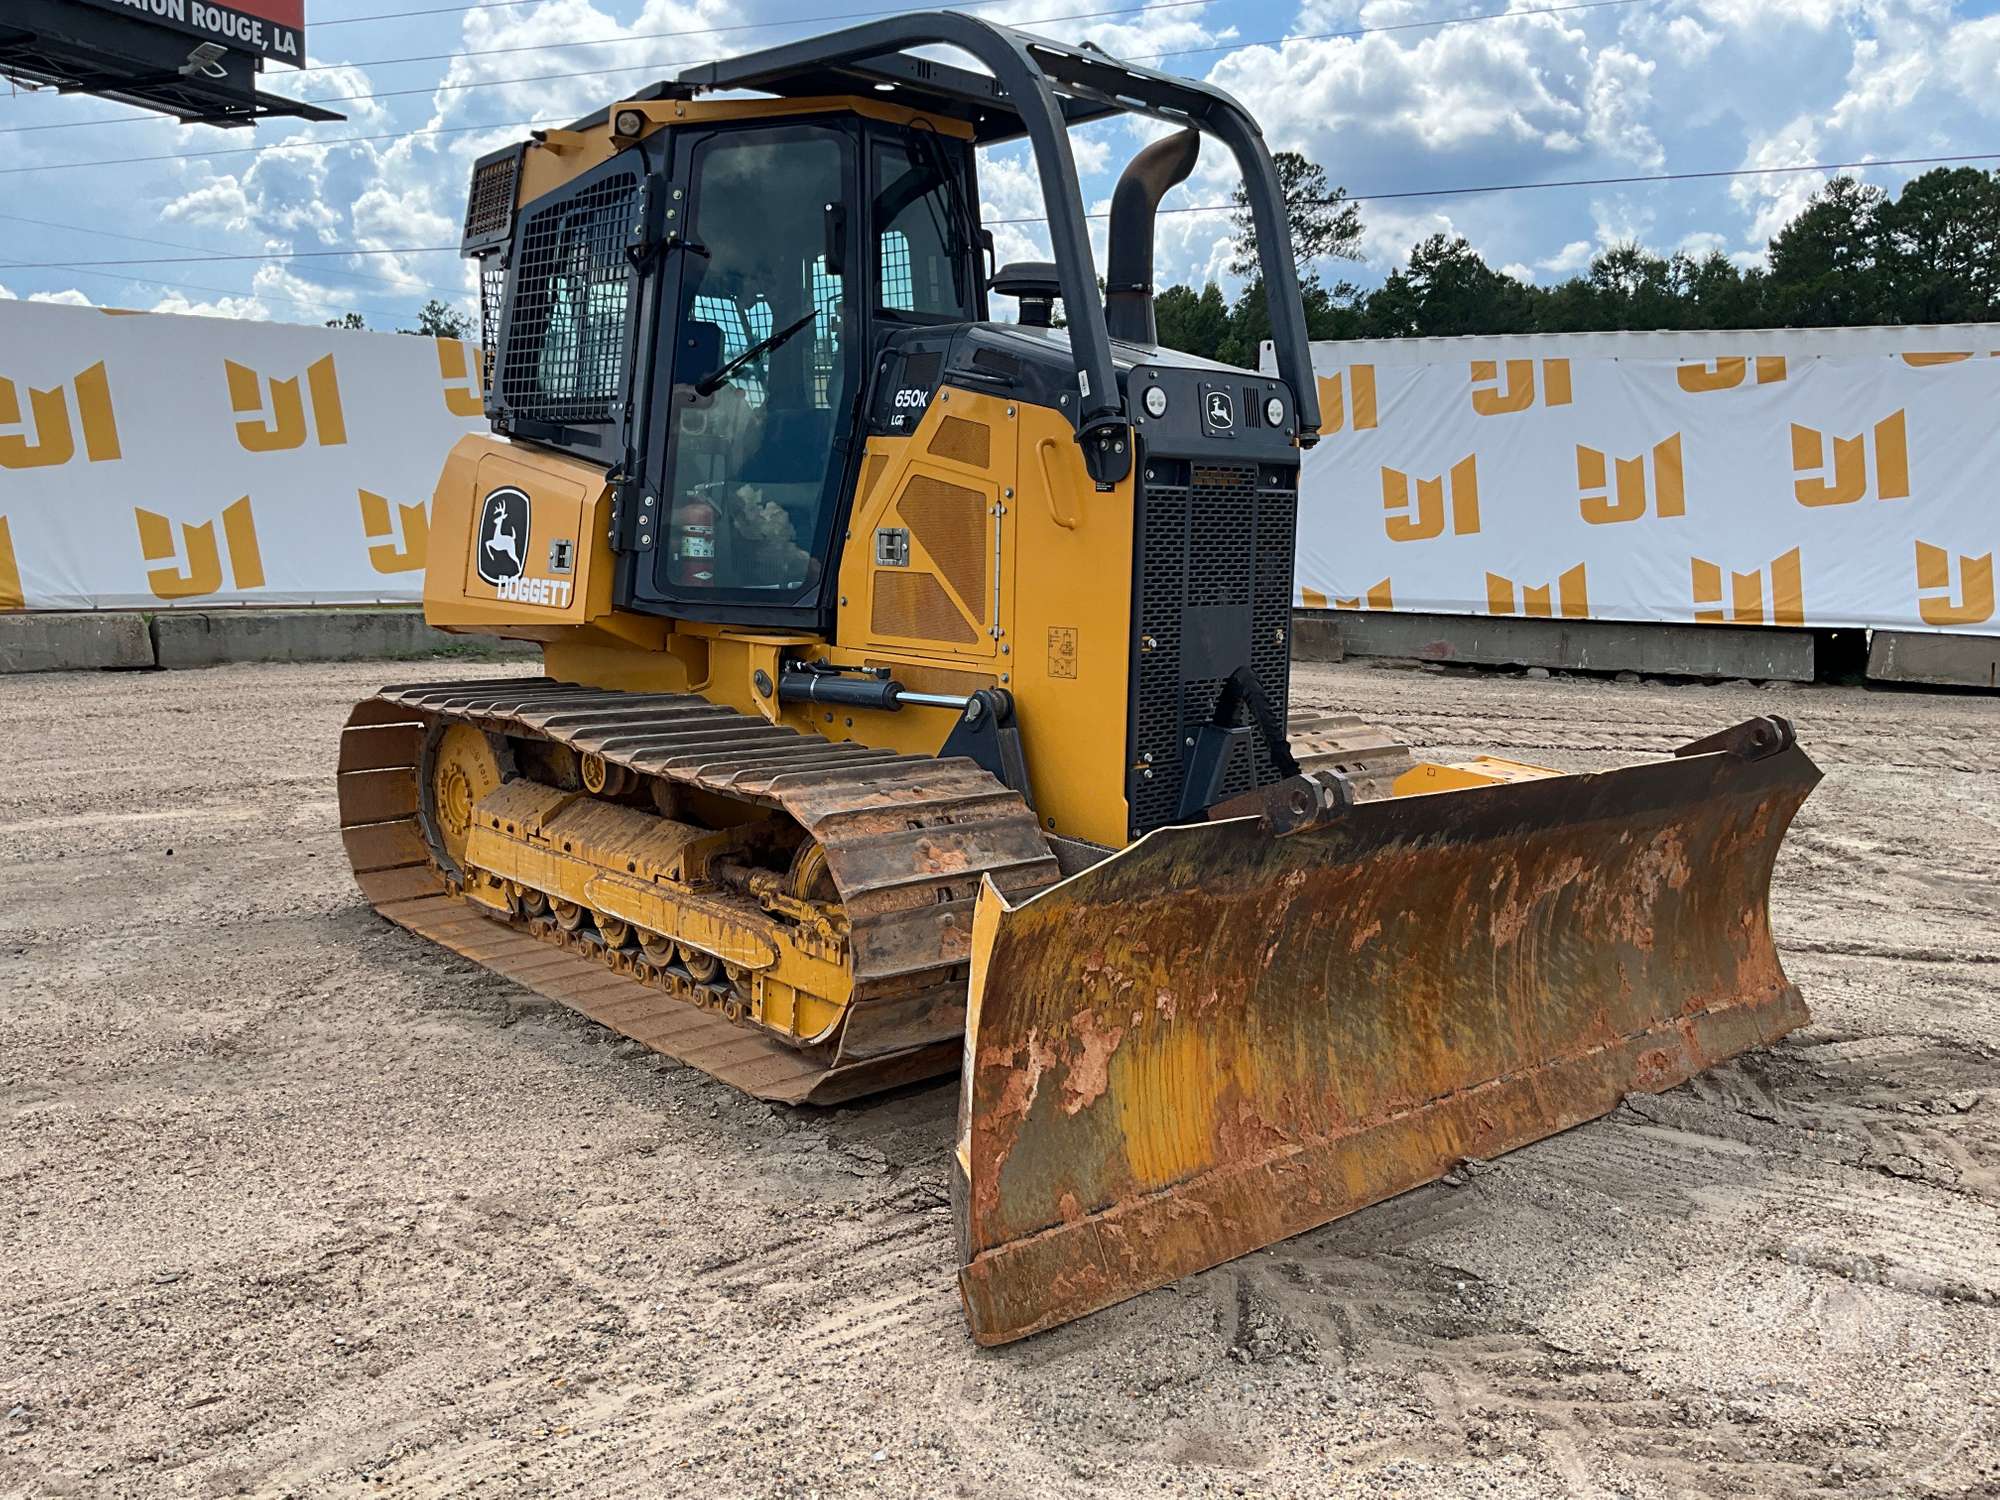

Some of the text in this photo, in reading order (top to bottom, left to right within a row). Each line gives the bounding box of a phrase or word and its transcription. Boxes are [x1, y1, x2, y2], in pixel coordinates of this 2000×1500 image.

[191, 1, 269, 50] ROUGE,
[273, 28, 297, 56] LA
[895, 389, 929, 408] 650K
[497, 574, 571, 610] DOGGETT
